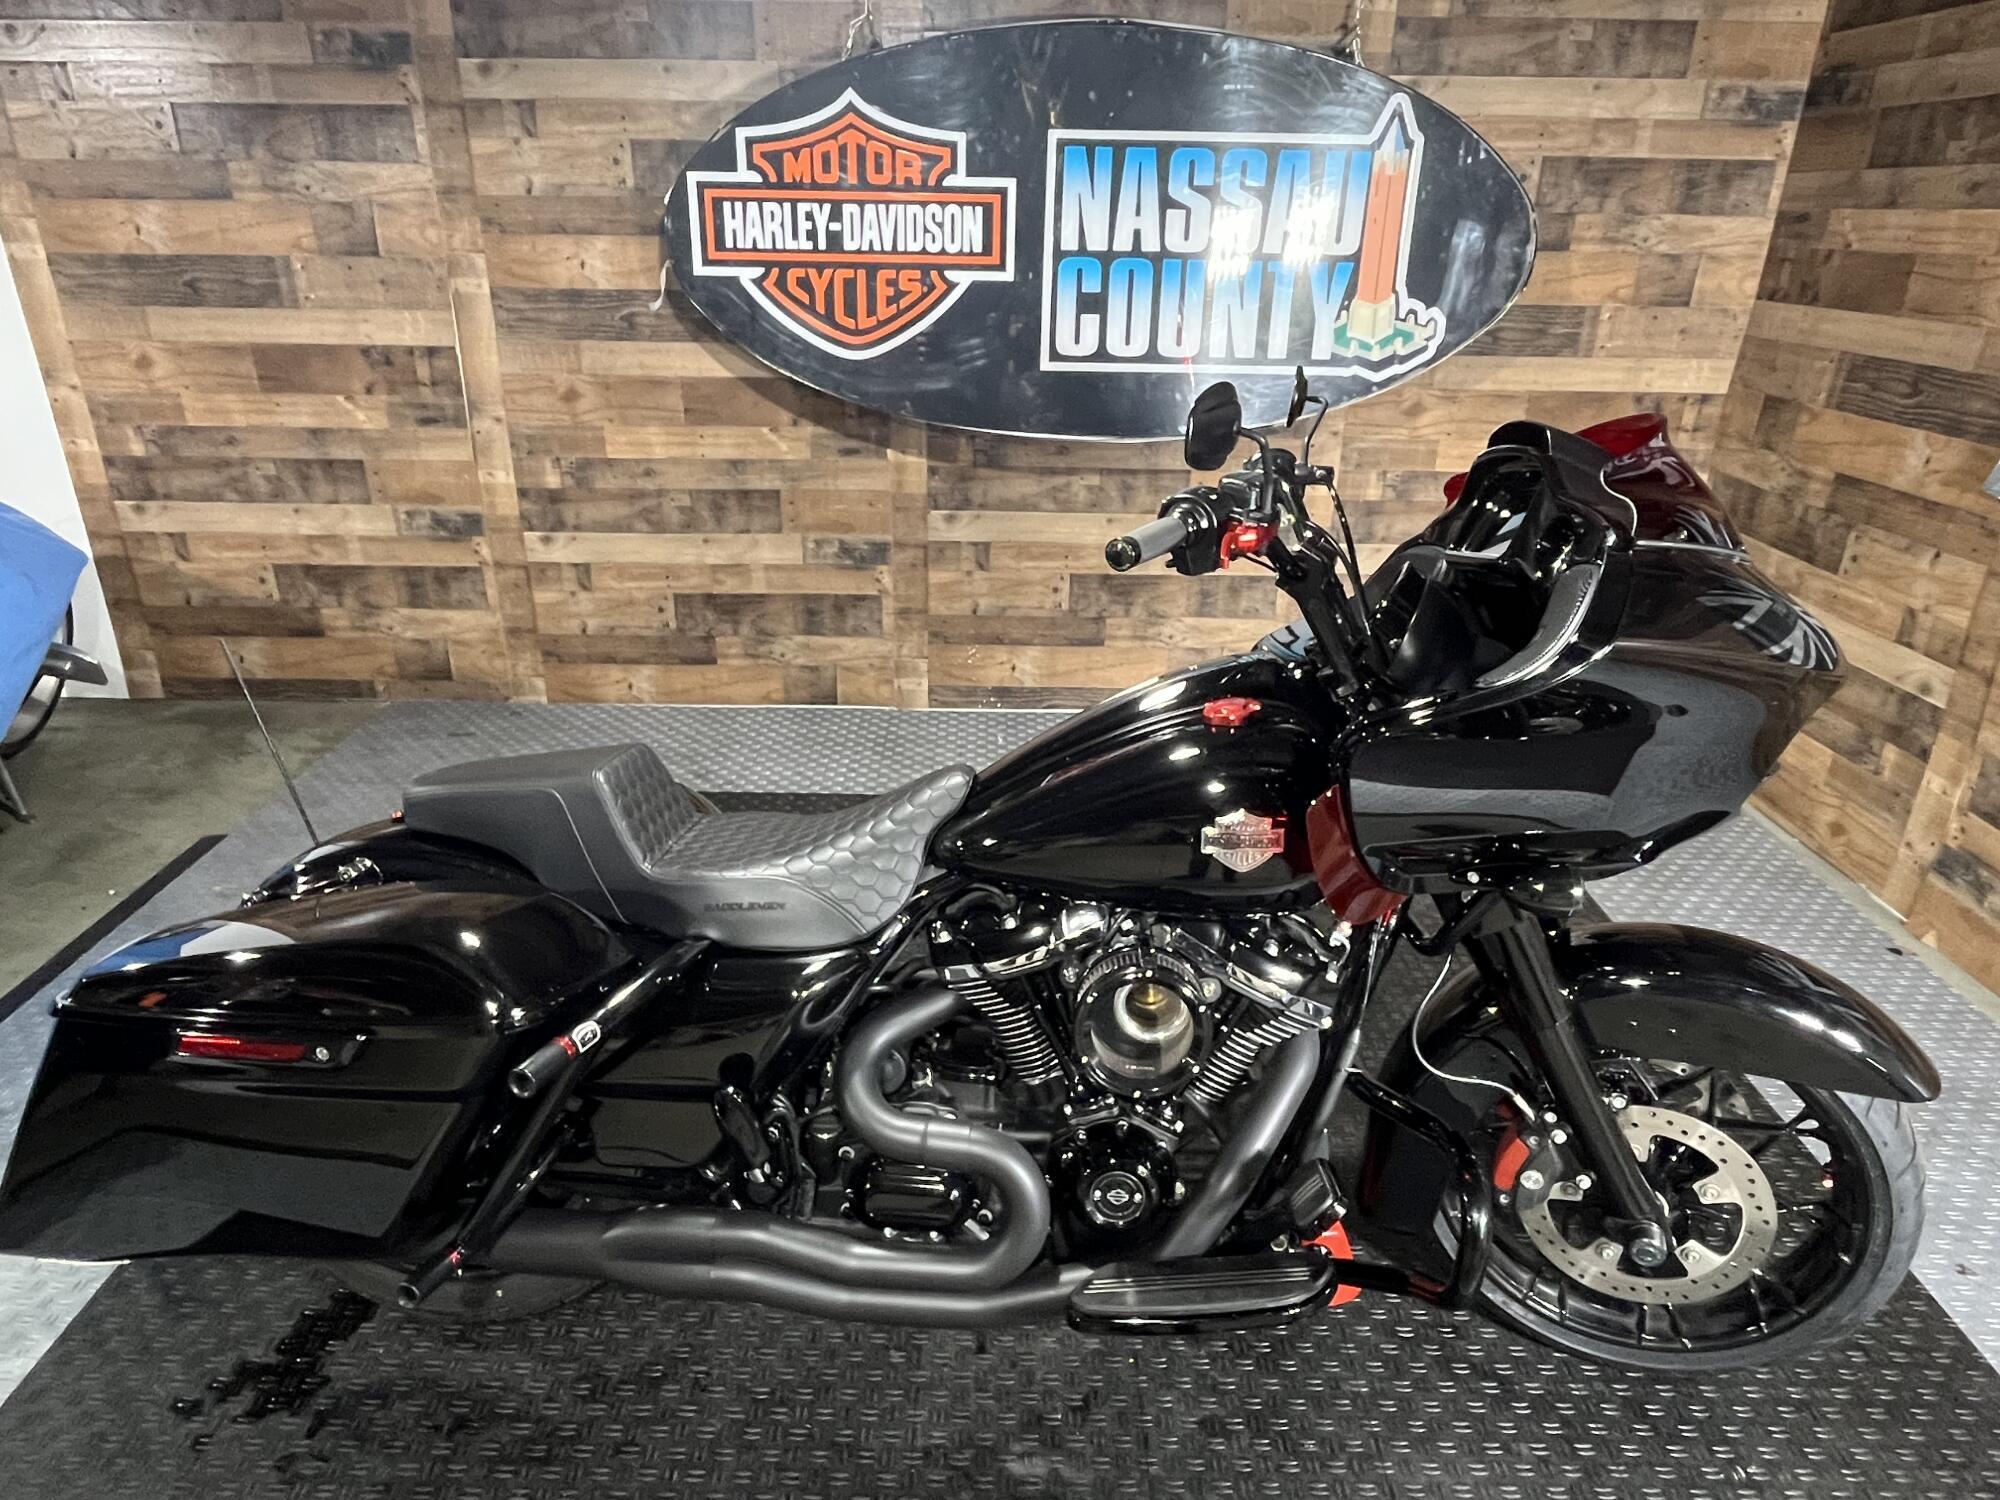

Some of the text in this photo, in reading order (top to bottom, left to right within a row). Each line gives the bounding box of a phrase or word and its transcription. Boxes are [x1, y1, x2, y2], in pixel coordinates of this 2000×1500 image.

[783, 128, 922, 186] MOTOR
[722, 200, 984, 254] HARLEY-DAVIDSON
[1060, 145, 1373, 256] NASSAU
[786, 267, 923, 330] CYCLES
[1055, 256, 1355, 360] COUNTY
